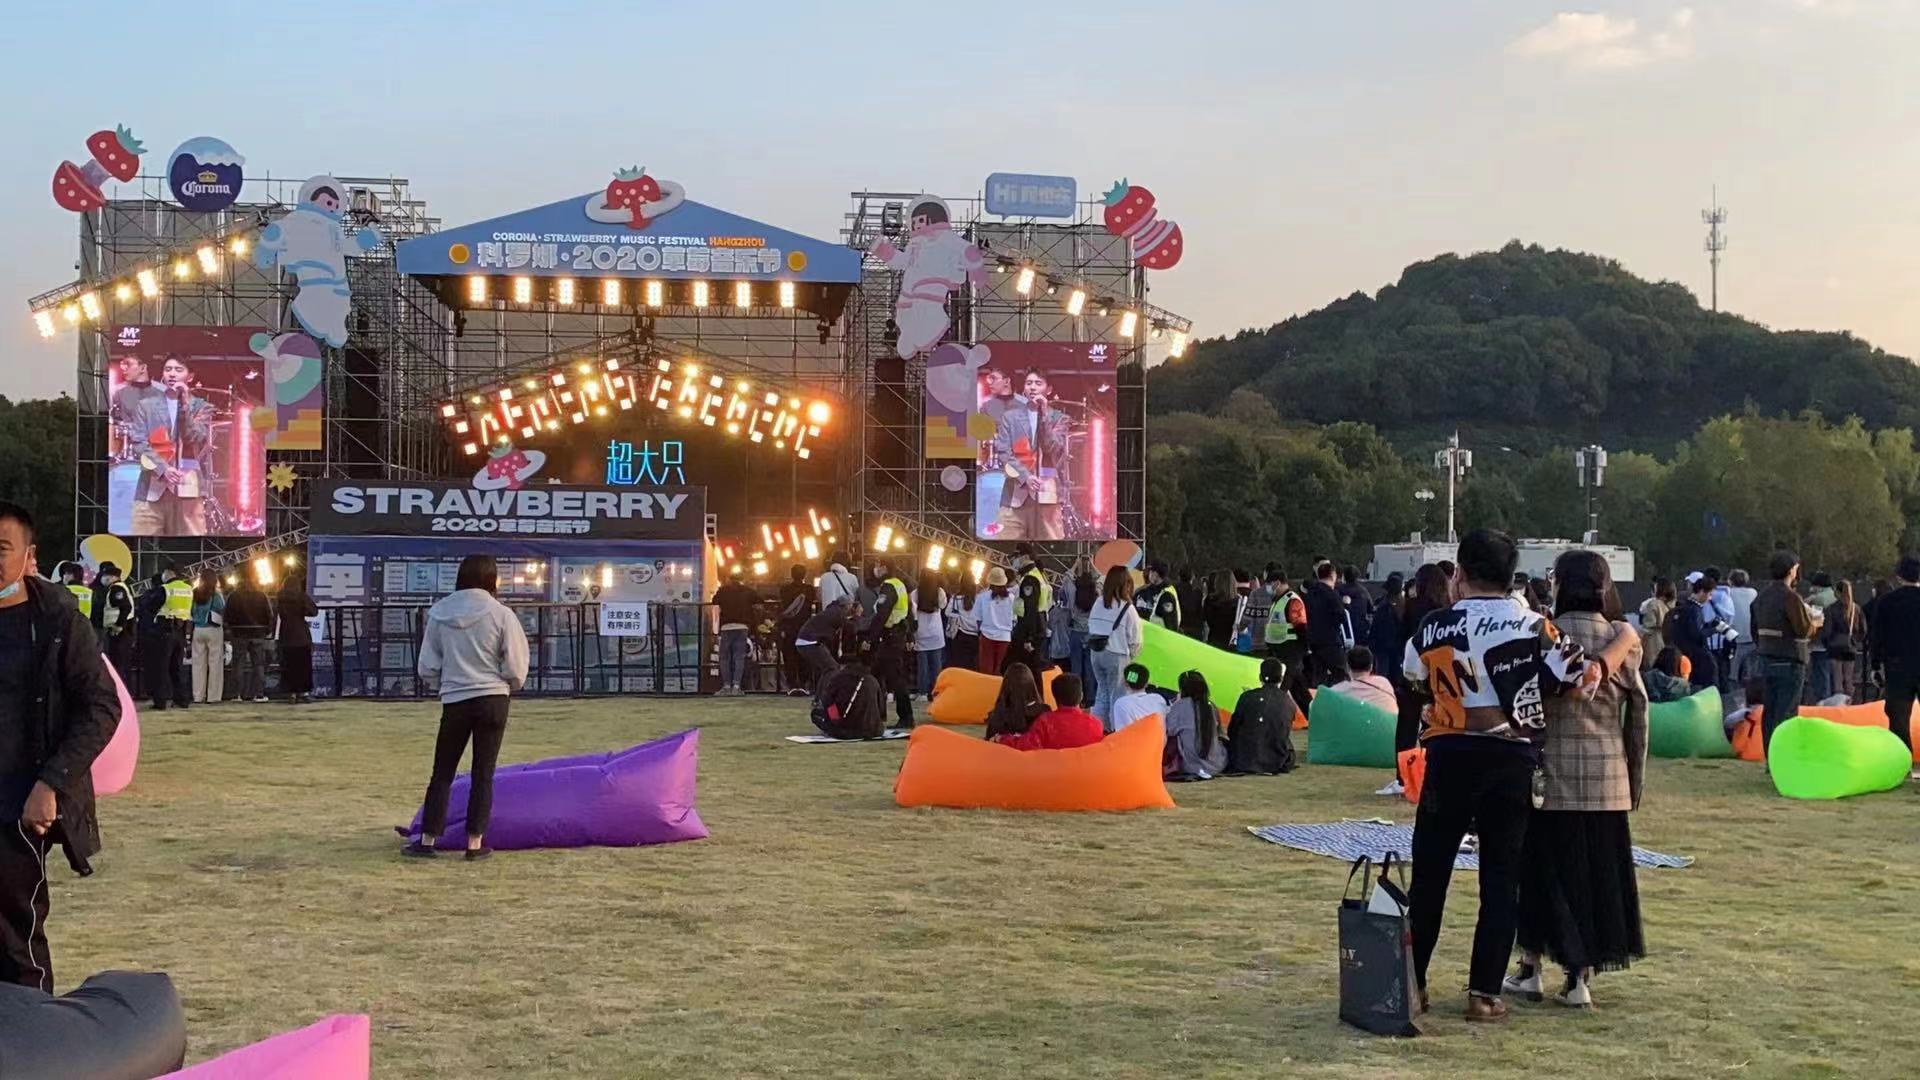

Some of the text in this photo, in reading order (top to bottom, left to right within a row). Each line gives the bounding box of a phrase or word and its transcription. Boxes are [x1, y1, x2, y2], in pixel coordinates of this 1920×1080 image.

[181, 180, 231, 197] Corona
[543, 233, 618, 244] STRAWBERRY
[620, 235, 656, 245] MUSIC
[658, 236, 707, 246] FESTIVAL
[709, 236, 766, 247] HANGZHOU
[606, 440, 686, 485] 超大只
[331, 487, 688, 519] STRAWBERRY
[607, 611, 641, 620] 注意安全
[607, 621, 641, 630] 有序通行
[1423, 616, 1527, 647] Work Hard
